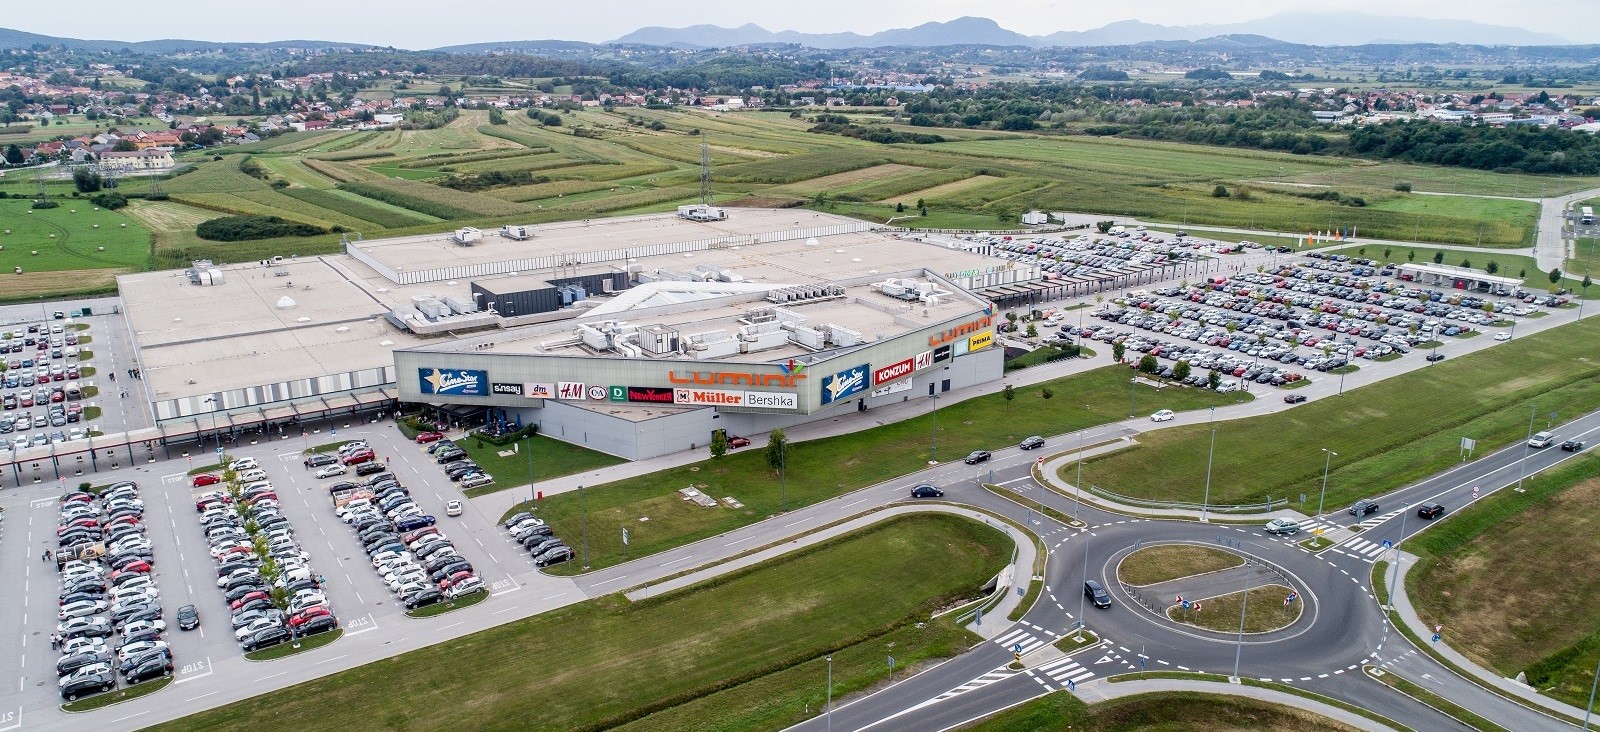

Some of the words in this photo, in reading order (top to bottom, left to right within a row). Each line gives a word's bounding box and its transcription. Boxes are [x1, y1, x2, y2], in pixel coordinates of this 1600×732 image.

[972, 336, 990, 346] PRIMA
[878, 361, 911, 382] KONZUM
[494, 384, 521, 394] sinsay
[533, 385, 546, 393] dm
[560, 384, 583, 398] H&M
[613, 388, 623, 397] D
[692, 391, 742, 404] Müller
[748, 394, 793, 407] Bershka
[167, 476, 184, 484] STOP
[35, 501, 54, 509] STOP
[492, 579, 510, 589] STOP
[349, 617, 369, 628] STOP
[182, 661, 203, 674] STOP
[0, 712, 13, 723] ST
